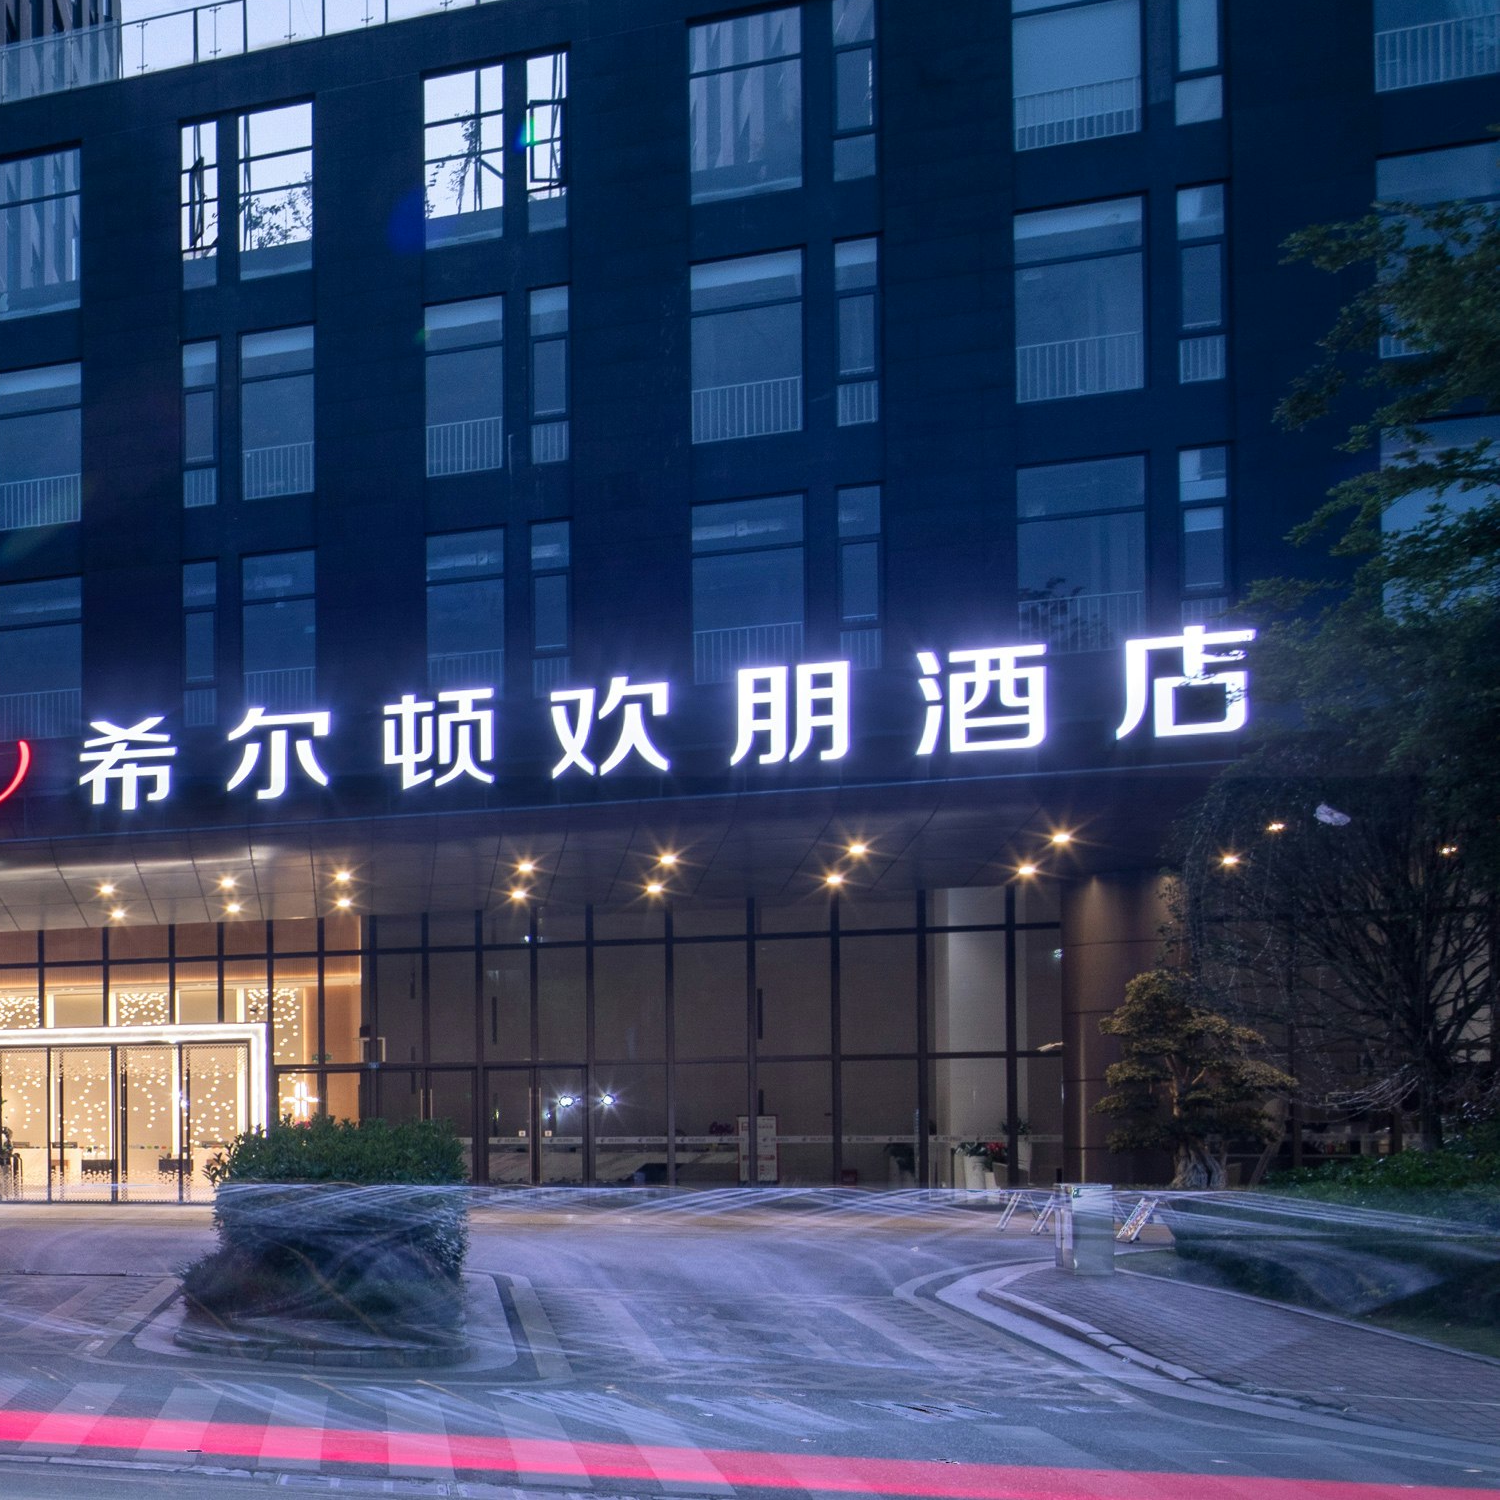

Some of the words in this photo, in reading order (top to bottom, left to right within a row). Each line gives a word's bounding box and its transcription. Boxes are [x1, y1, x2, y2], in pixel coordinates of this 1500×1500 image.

[78, 624, 1257, 812] 希尔顿欢朋酒店
